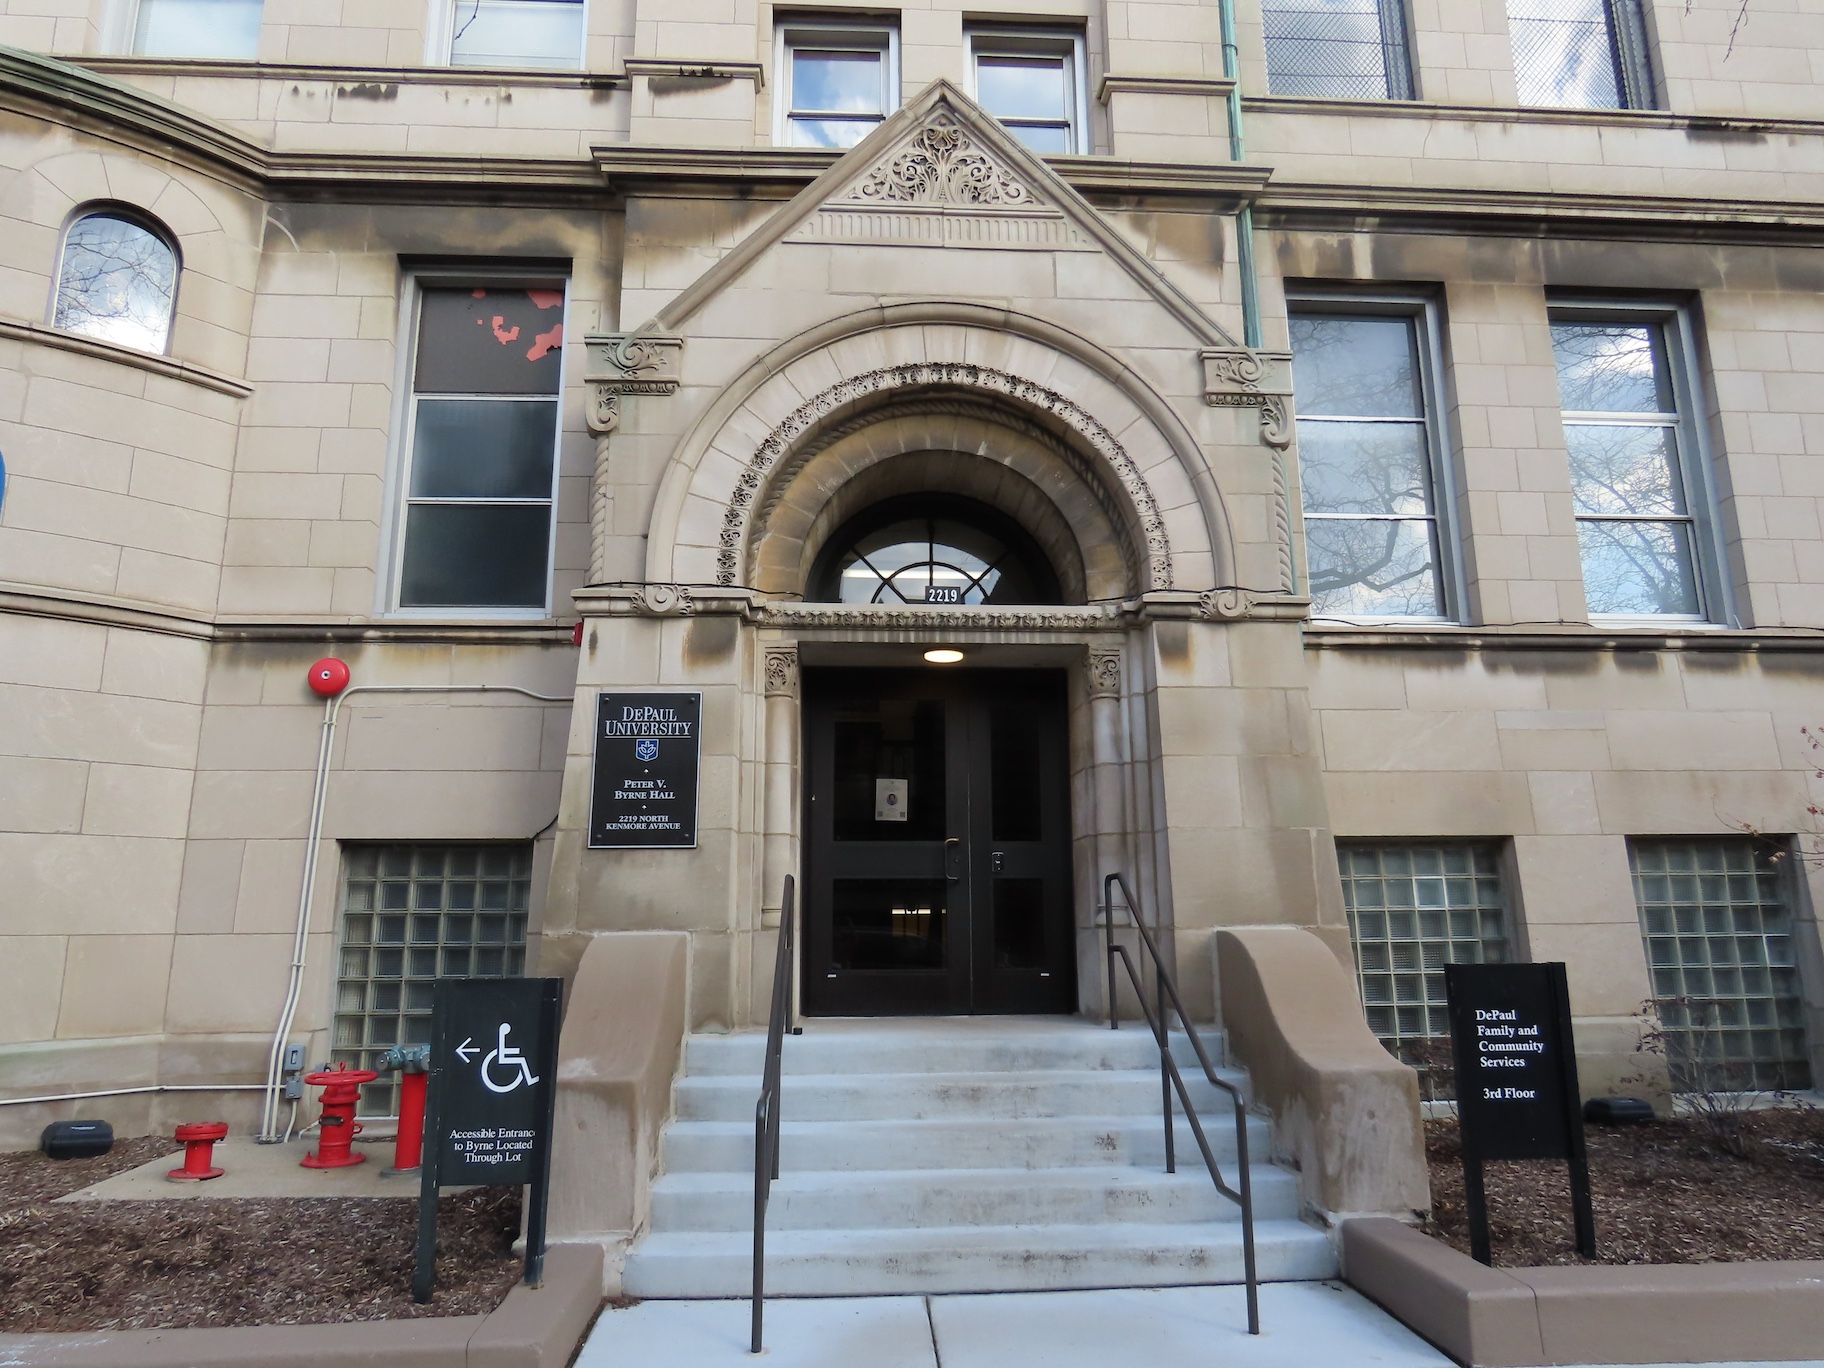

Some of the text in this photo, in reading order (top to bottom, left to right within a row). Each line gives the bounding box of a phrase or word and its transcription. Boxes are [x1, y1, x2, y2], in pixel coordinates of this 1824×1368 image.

[928, 588, 958, 602] 2219
[605, 720, 692, 736] UNIVERSITY
[624, 780, 667, 789] PETER V.
[614, 790, 676, 800] BYRNE HALL
[618, 815, 638, 823] 2219
[606, 822, 681, 830] KENMORE AVENUE
[1475, 1009, 1517, 1021] DePaul
[1477, 1025, 1539, 1039] Family and
[1479, 1040, 1544, 1054] Community
[1480, 1055, 1526, 1068] Services
[1483, 1087, 1536, 1099] 3rd Floor
[449, 1128, 536, 1139] Accessible Entranc
[454, 1140, 533, 1153] to Byrne Located
[464, 1152, 522, 1165] Through Lot
